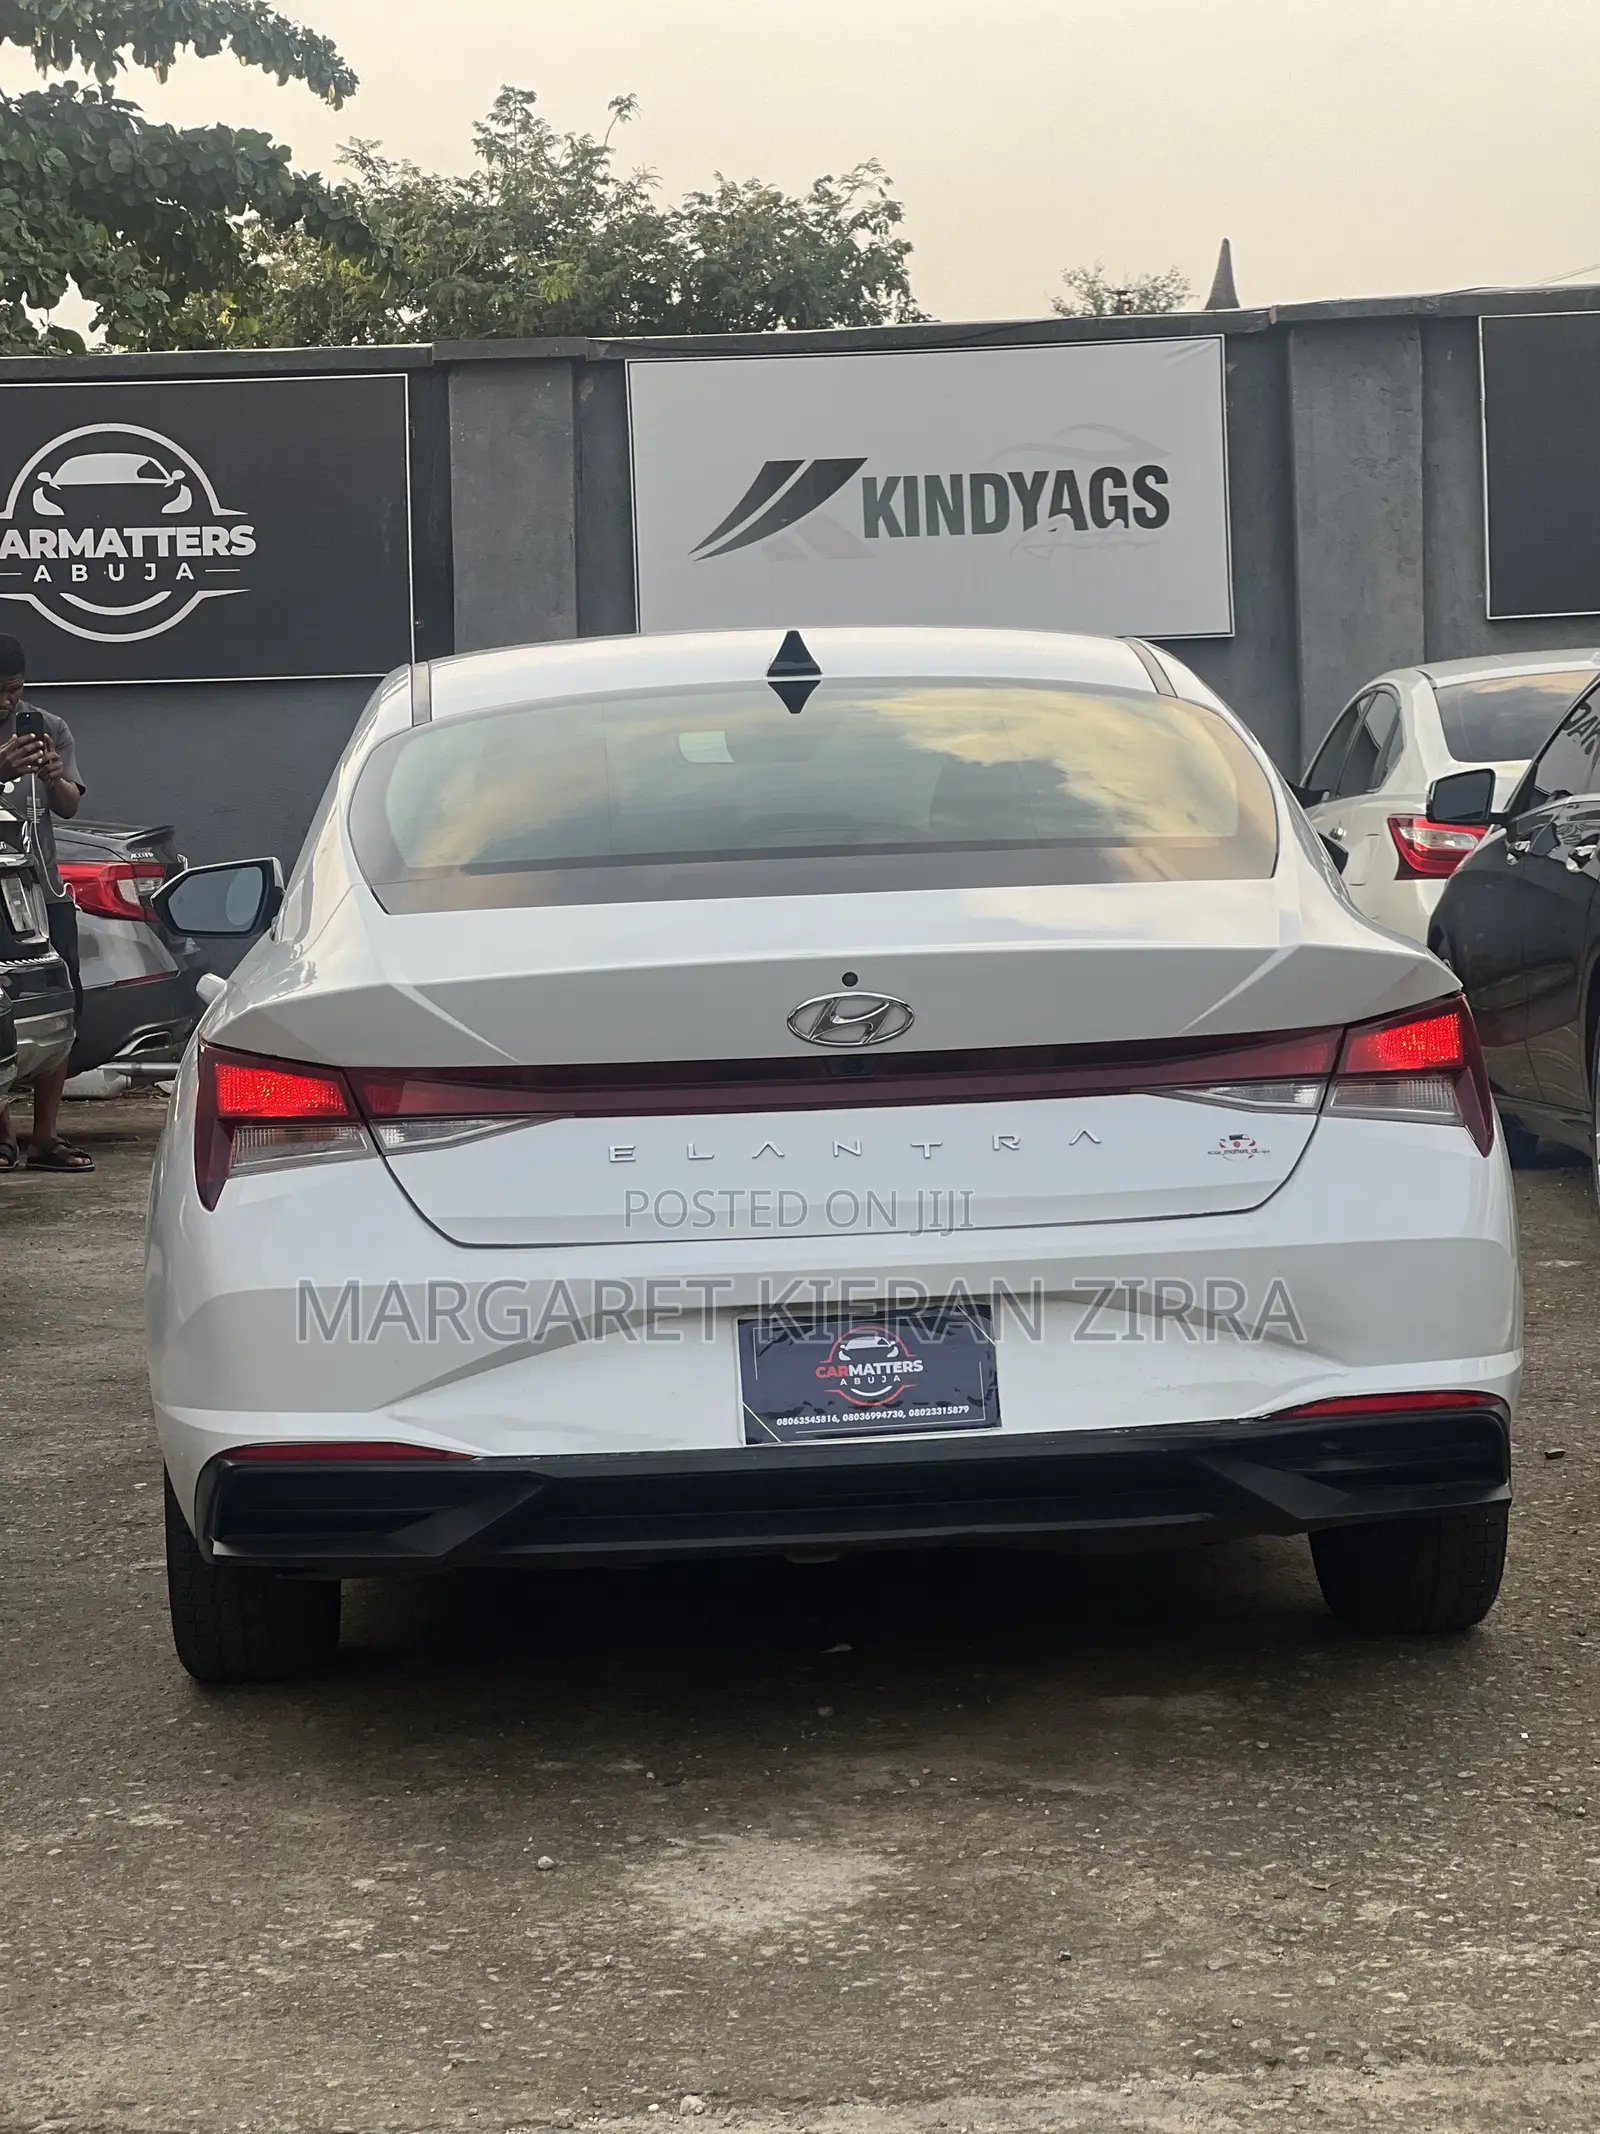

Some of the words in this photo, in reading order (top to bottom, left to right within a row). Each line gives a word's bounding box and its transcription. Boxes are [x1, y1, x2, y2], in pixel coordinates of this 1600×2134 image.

[862, 464, 1171, 540] KINDYAGS
[0, 525, 256, 560] ARMATTERS
[33, 562, 195, 583] ABUJA
[608, 1128, 1102, 1163] ELANTRA
[815, 1359, 923, 1379] CARMATTERS
[840, 1375, 901, 1386] ABUJA
[776, 1414, 840, 1426] 08063545816,
[842, 1408, 906, 1422] 08036994730,
[908, 1405, 969, 1417] 08023315879
